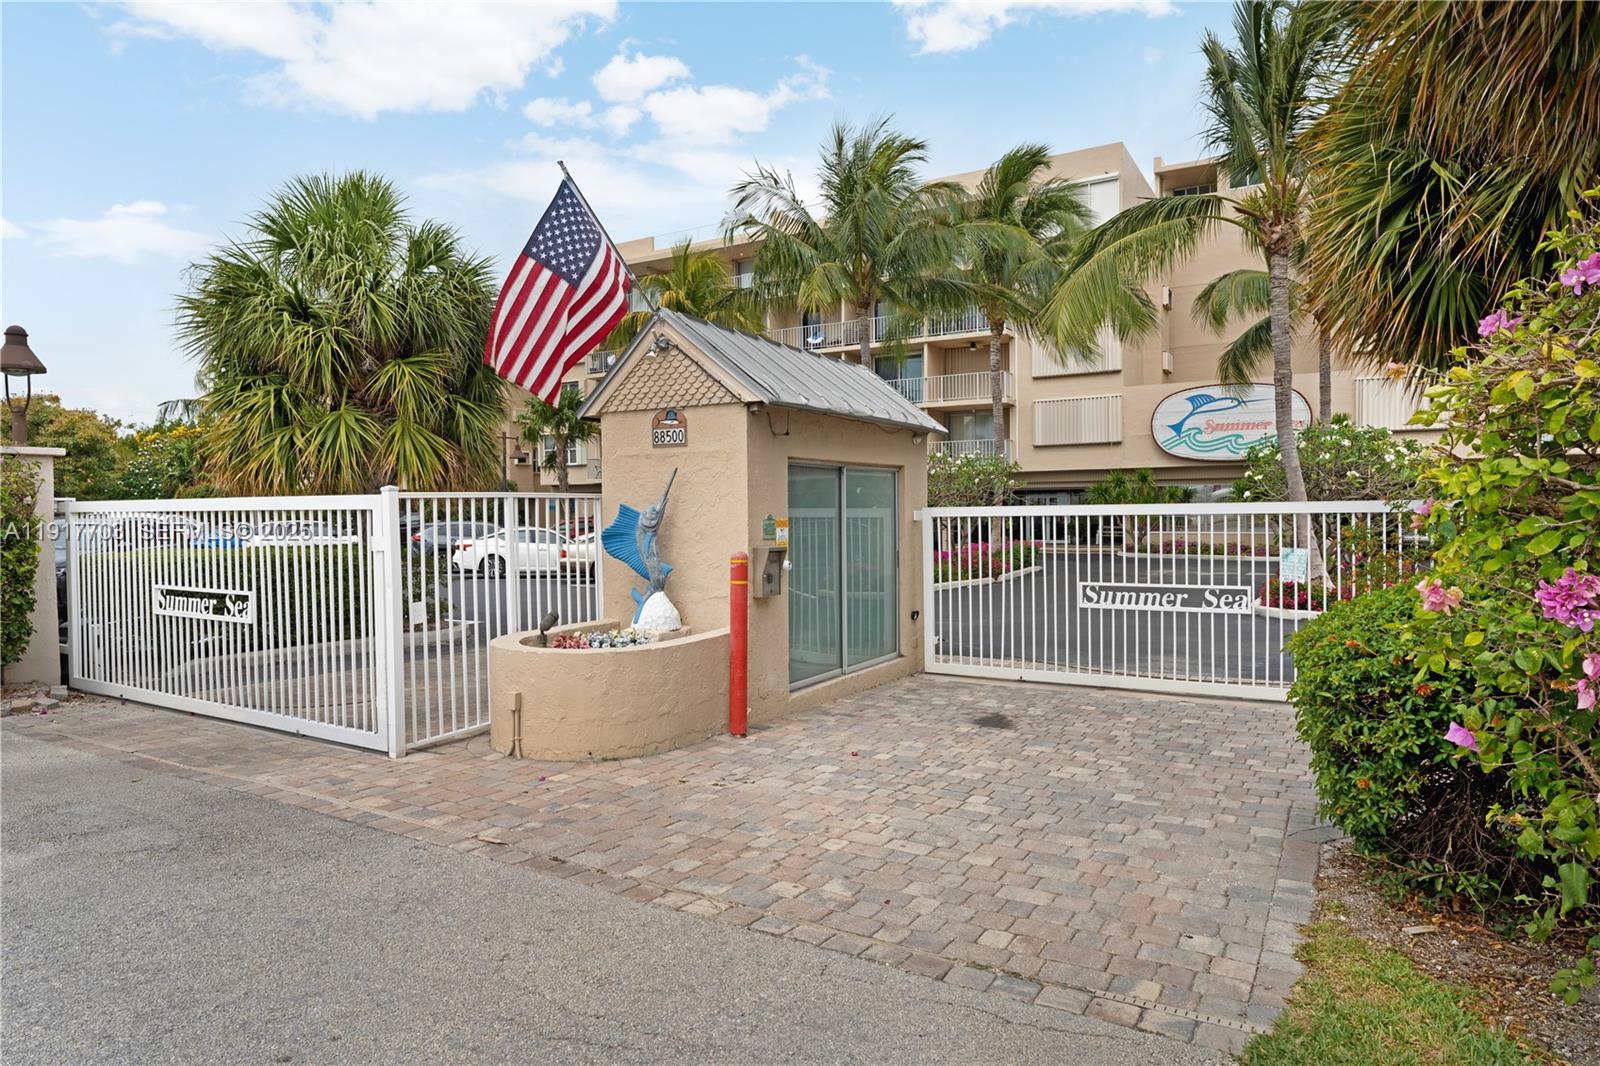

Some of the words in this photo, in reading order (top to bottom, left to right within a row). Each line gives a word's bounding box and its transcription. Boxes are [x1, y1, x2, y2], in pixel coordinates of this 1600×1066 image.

[1204, 419, 1272, 434] Summer
[653, 430, 684, 443] 88500
[158, 589, 217, 615] Summer
[224, 594, 249, 618] Sea
[1083, 585, 1189, 607] Summer
[1202, 588, 1248, 609] Sea
